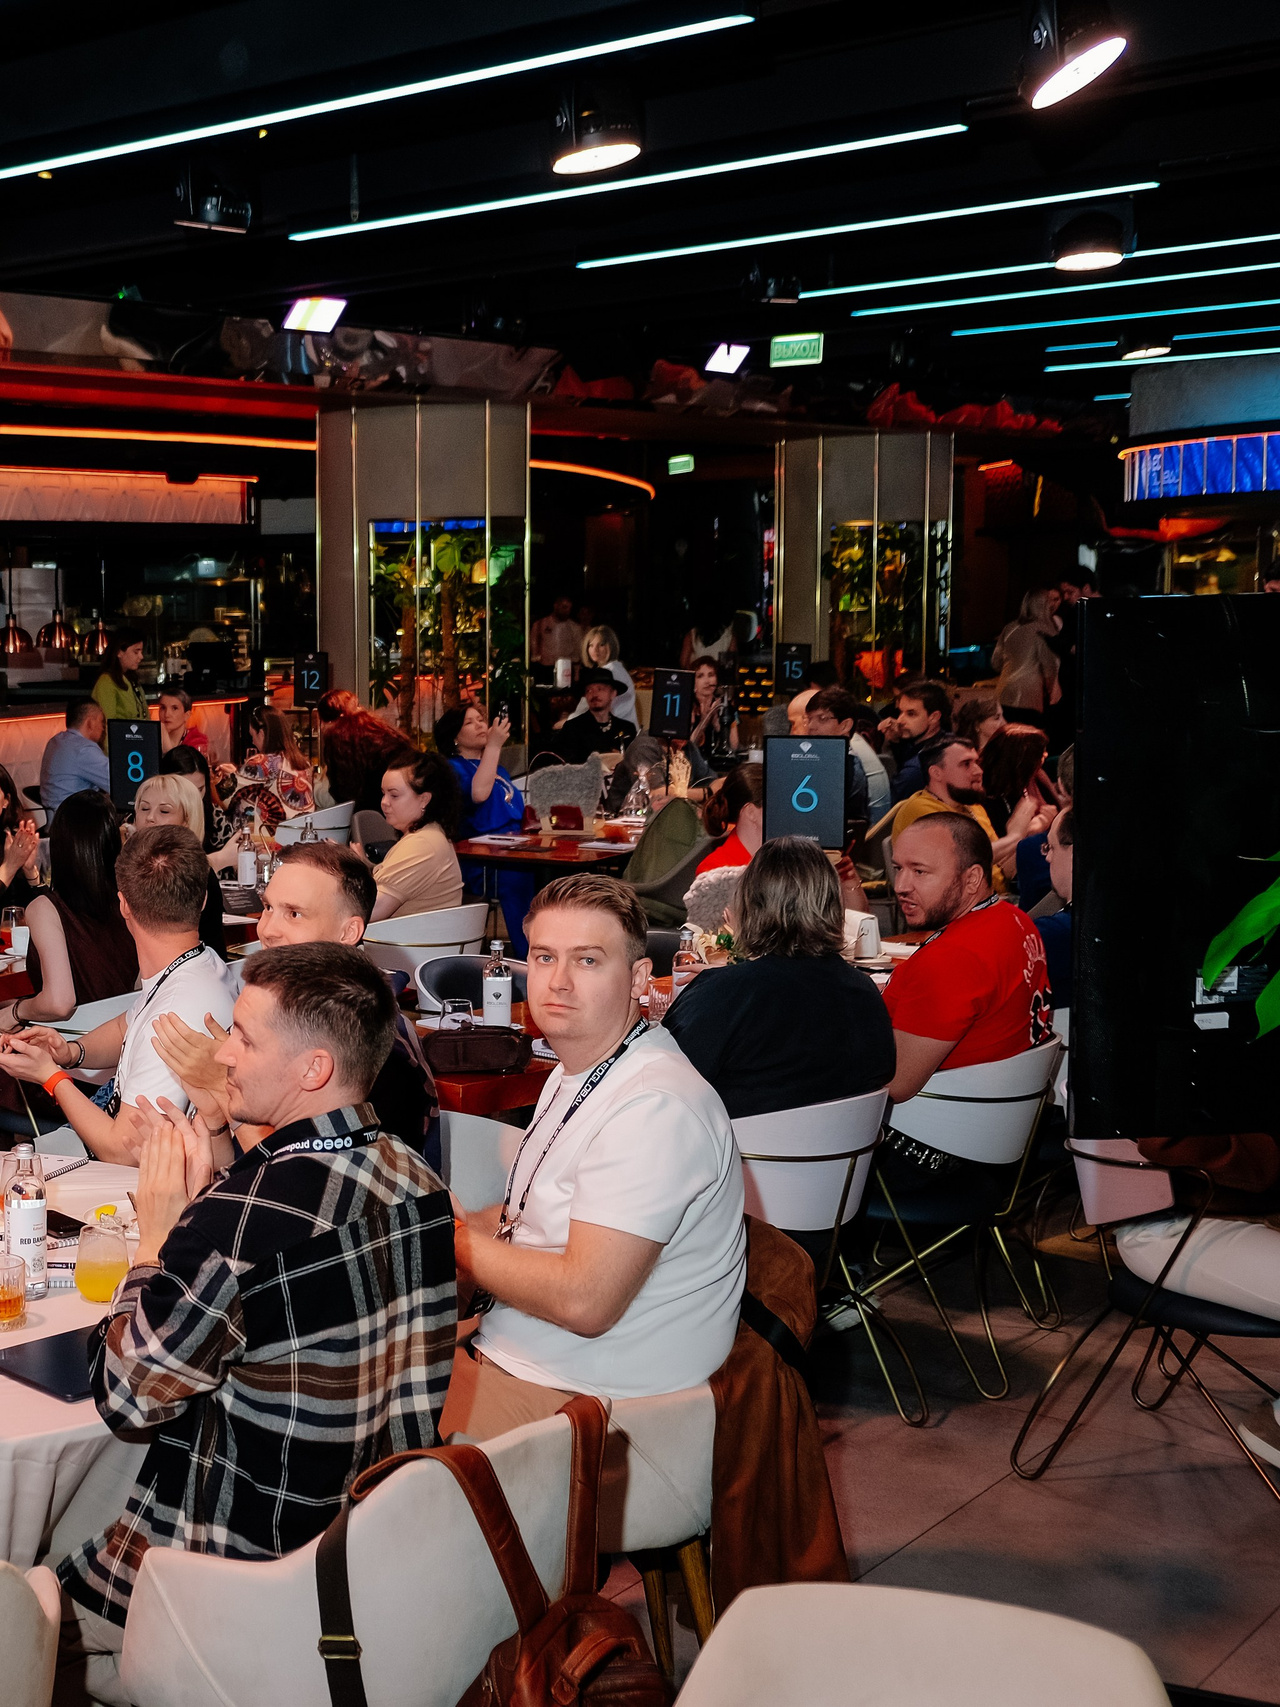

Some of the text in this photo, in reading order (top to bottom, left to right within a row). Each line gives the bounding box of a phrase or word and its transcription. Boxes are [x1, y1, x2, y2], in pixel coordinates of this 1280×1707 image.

[774, 340, 819, 359] ВЫХОД
[301, 670, 320, 690] 12
[783, 660, 803, 679] 15
[663, 693, 681, 717] 11
[127, 751, 144, 783] 8
[791, 773, 819, 813] 6
[571, 1061, 610, 1108] EDGLOBAL
